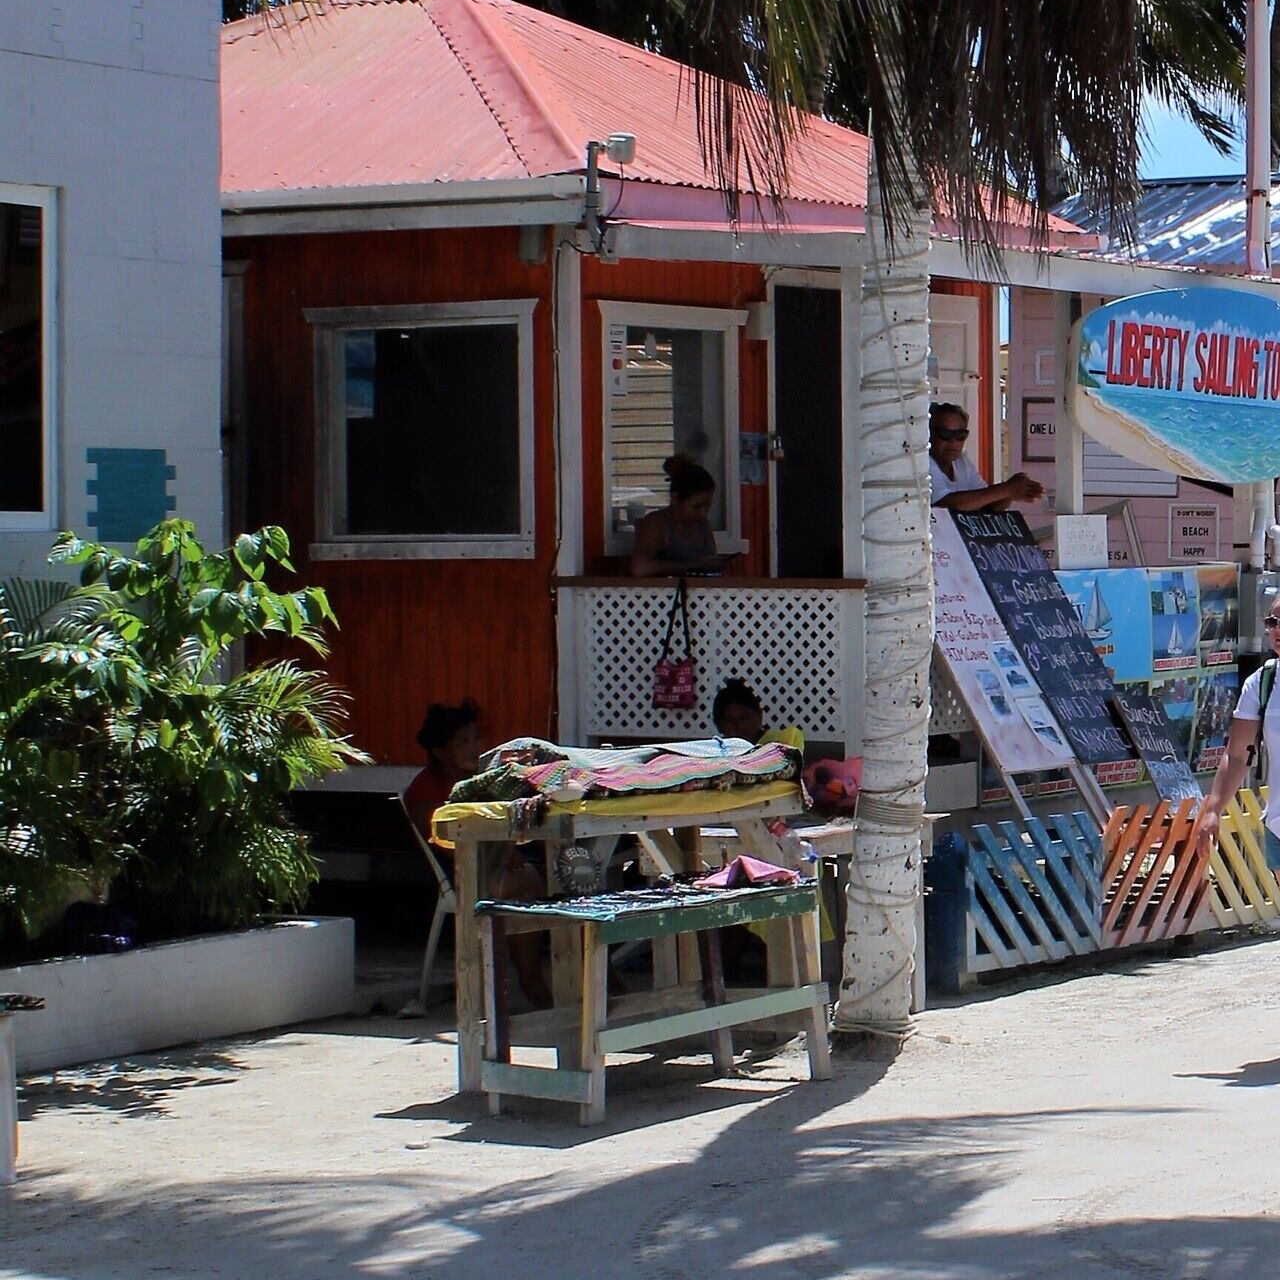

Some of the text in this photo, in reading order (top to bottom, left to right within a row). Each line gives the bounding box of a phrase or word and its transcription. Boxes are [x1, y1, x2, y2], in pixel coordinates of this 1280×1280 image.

[1106, 320, 1192, 392] LIBERTY
[1193, 331, 1260, 400] SAILING
[1029, 423, 1047, 435] ONE
[957, 512, 1024, 539] SAILING
[1182, 526, 1209, 537] BEACH
[1114, 552, 1122, 561] IS
[1122, 552, 1128, 561] A
[1183, 547, 1205, 556] HAPPY
[1121, 699, 1165, 726] Sunset
[1132, 724, 1178, 763] Sailing
